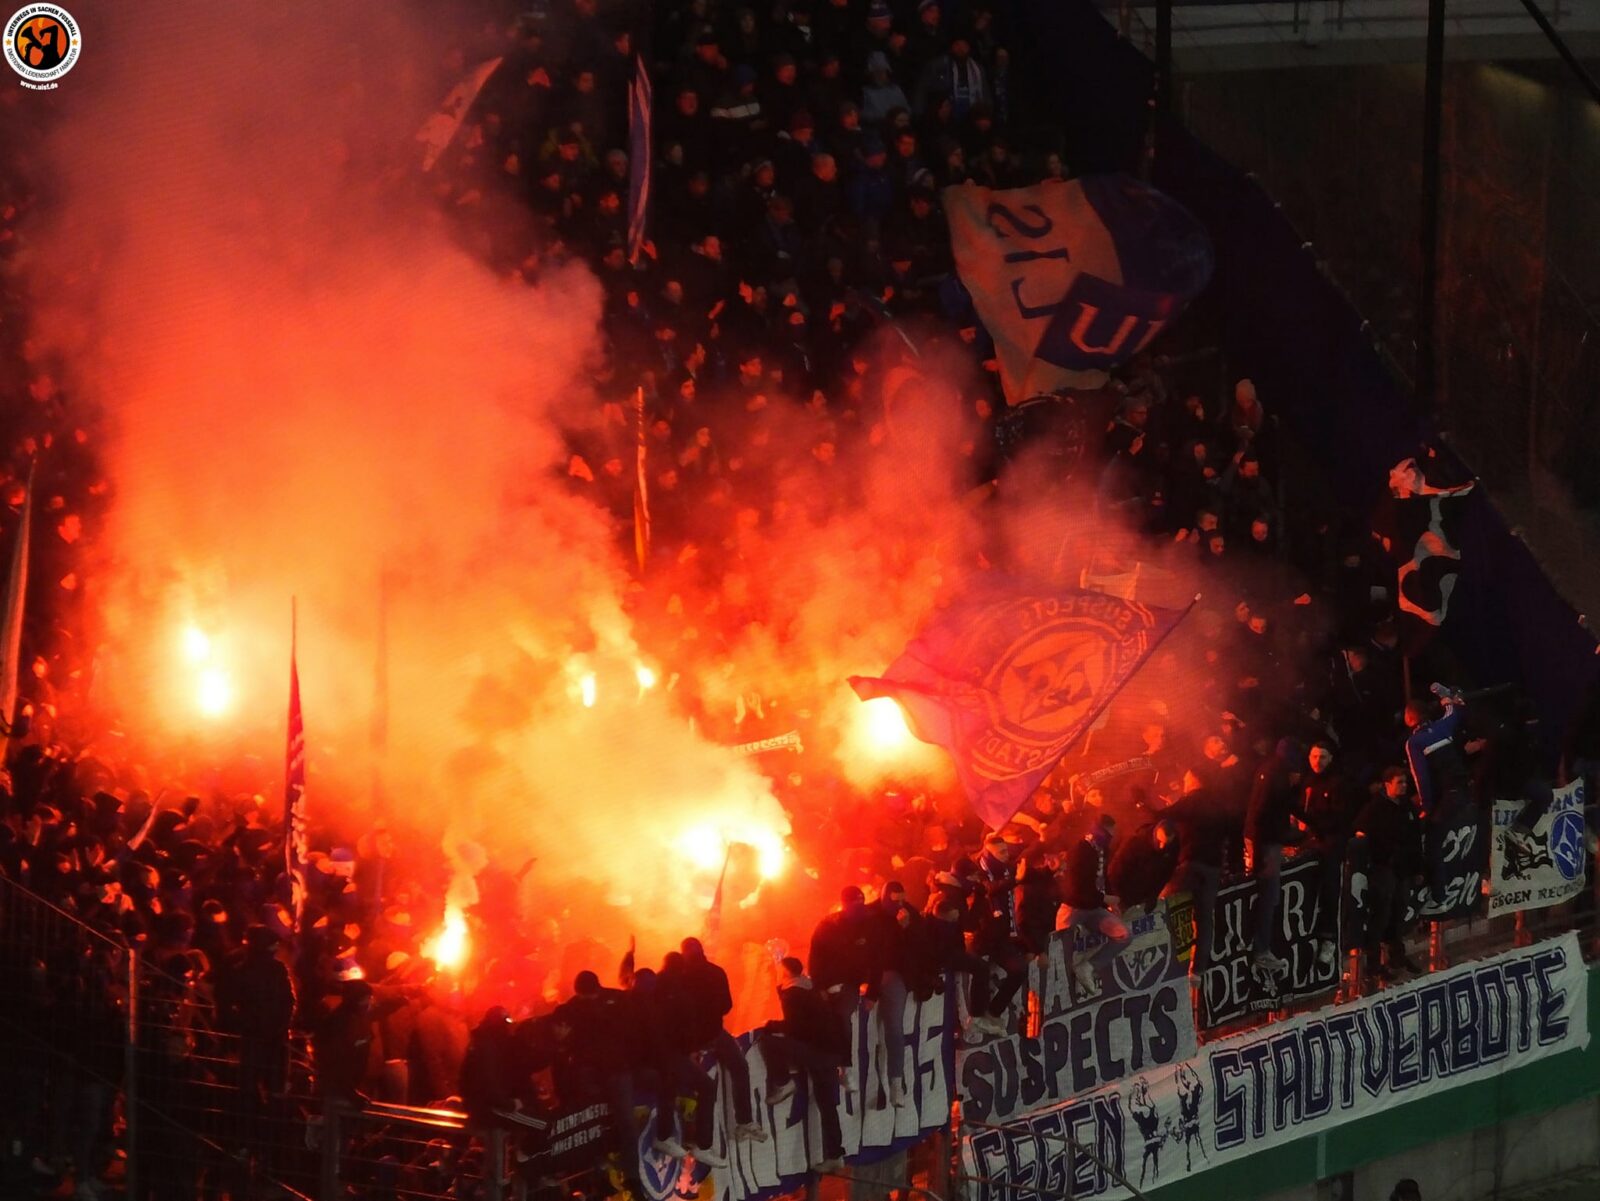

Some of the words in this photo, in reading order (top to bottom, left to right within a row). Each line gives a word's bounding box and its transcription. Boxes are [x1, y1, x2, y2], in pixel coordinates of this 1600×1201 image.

[1491, 889, 1533, 909] GEGEN
[962, 985, 1178, 1126] SUSPECTS
[970, 1092, 1128, 1201] GEGEN
[1210, 946, 1570, 1151] STADTVERBOTE
